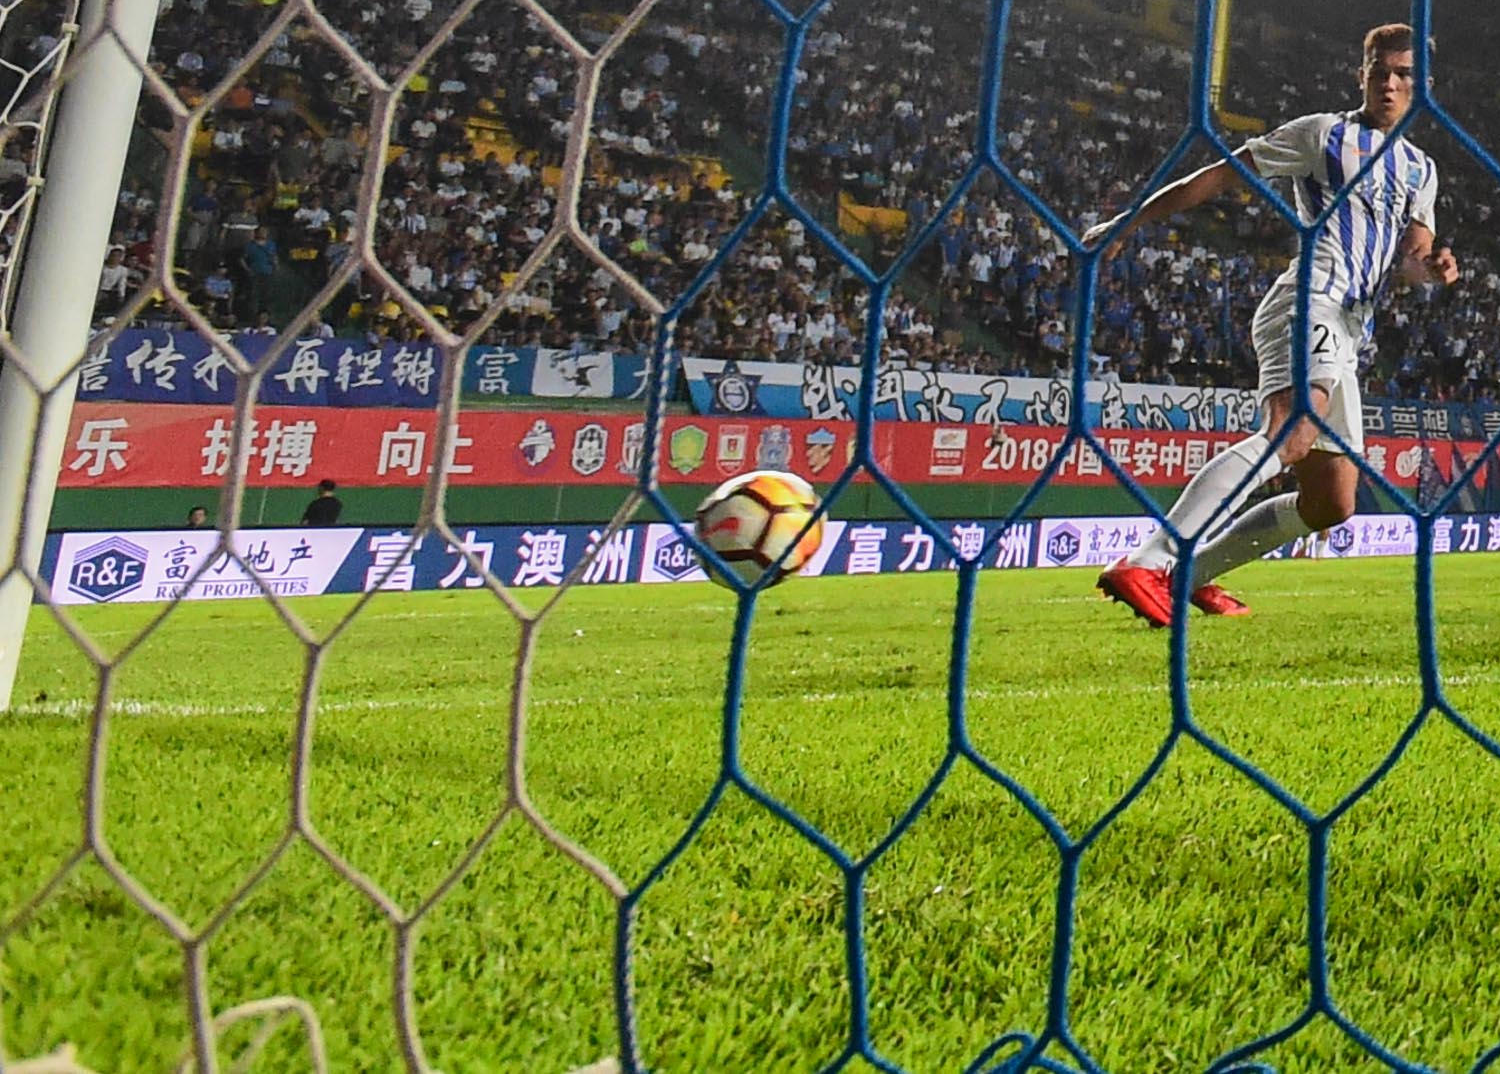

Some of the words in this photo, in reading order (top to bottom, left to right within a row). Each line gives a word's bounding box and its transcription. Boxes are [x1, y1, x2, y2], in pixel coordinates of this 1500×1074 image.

[69, 418, 128, 477] 乐
[201, 419, 317, 477] 拼搏
[376, 421, 473, 478] 向上
[364, 528, 634, 592] 富力澳洲
[847, 523, 1031, 575] 富力澳洲
[1050, 536, 1077, 556] R&F
[76, 562, 140, 587] R&F
